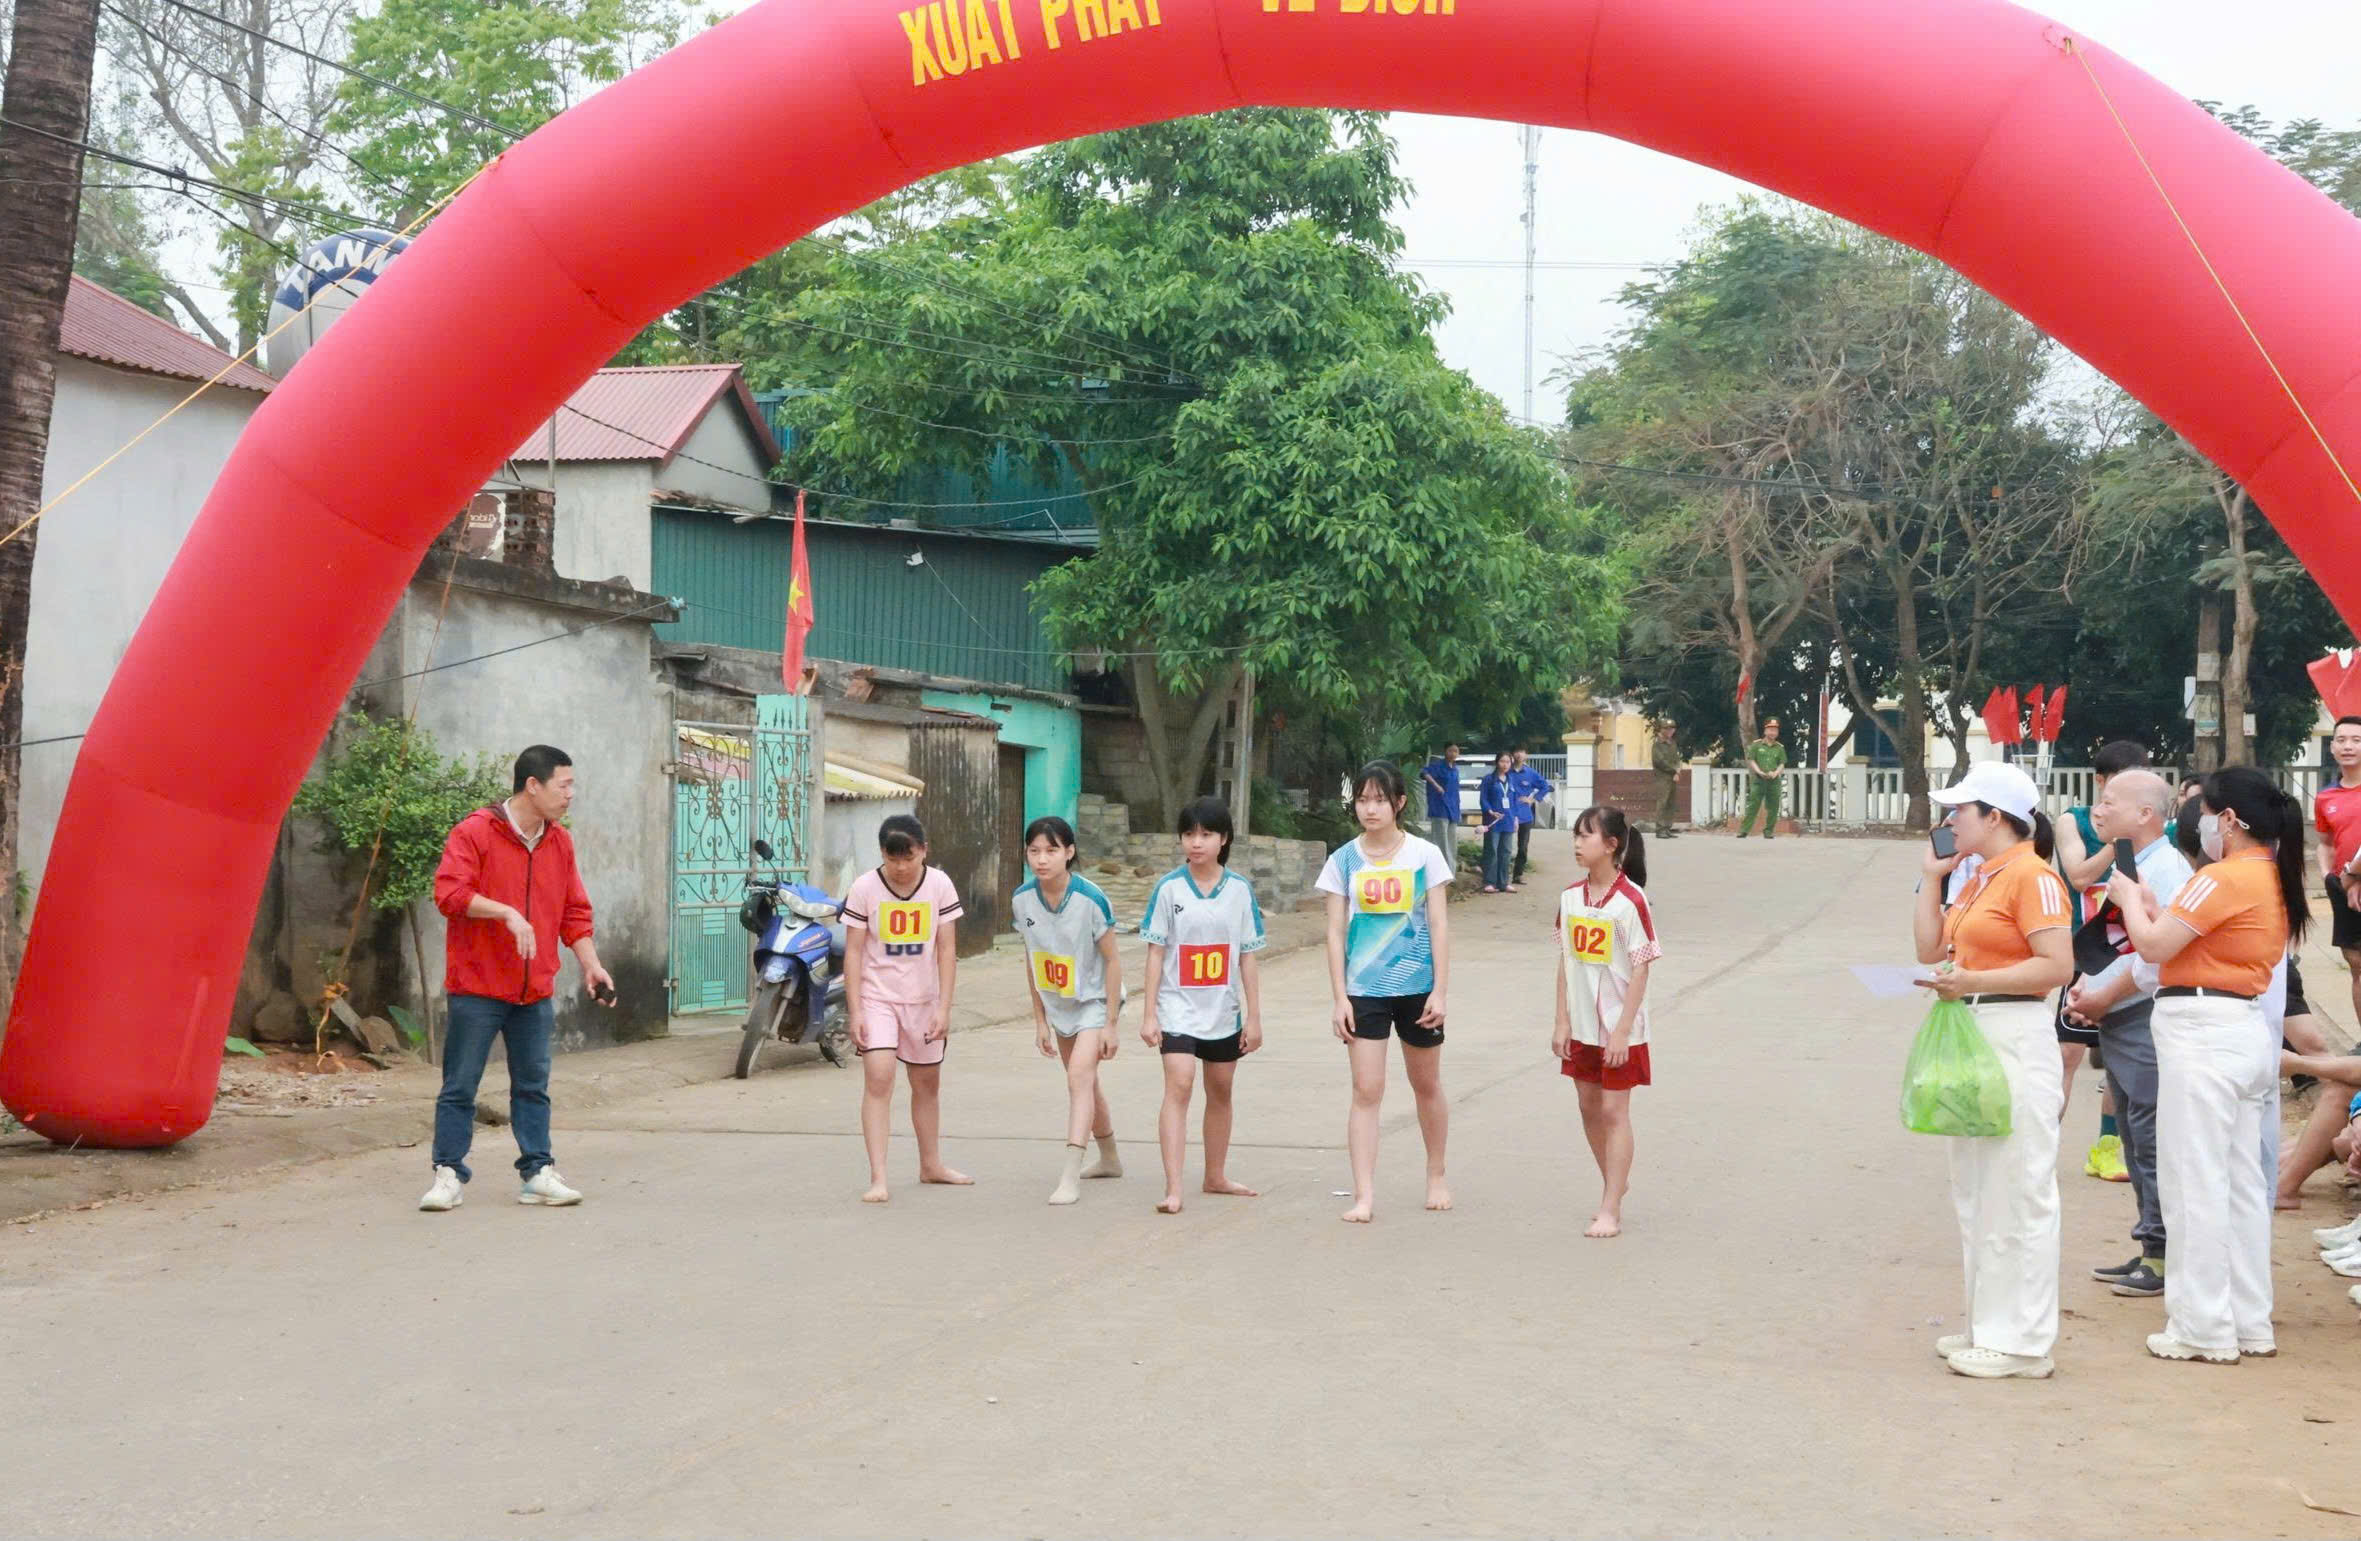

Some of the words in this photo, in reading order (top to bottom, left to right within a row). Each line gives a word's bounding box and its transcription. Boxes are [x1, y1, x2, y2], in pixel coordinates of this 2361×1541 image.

[1364, 877, 1402, 904] 90
[889, 909, 921, 936] 01
[1574, 924, 1606, 955] 02
[1044, 959, 1068, 988] 09
[1191, 951, 1223, 980] 10
